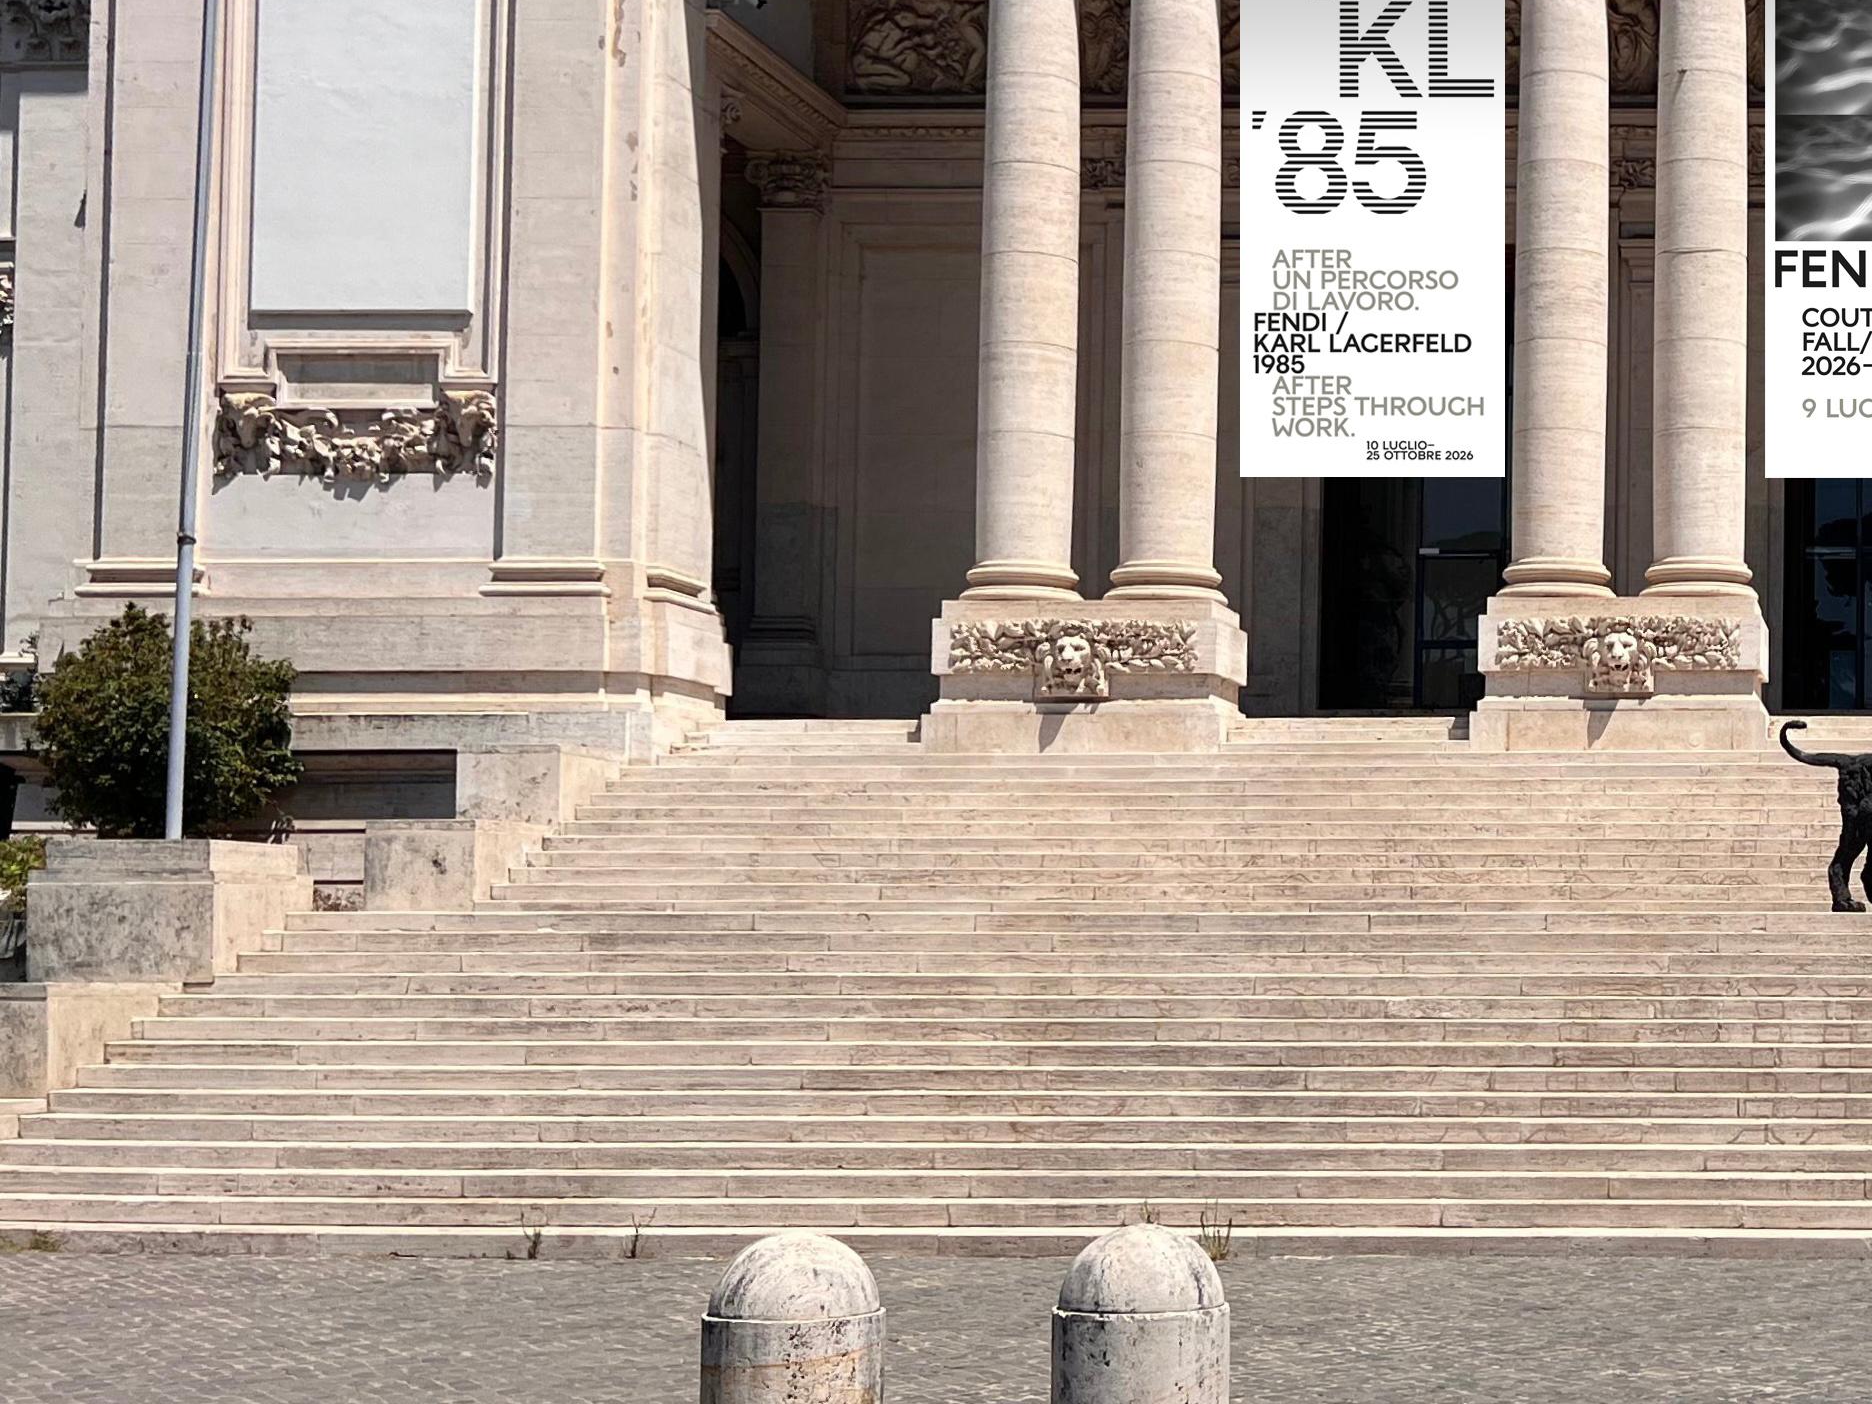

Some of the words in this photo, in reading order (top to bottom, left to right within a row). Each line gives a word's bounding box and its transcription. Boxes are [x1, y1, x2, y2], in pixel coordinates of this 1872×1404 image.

[1252, 110, 1427, 215] '85
[1272, 249, 1351, 268] AFTER
[1273, 270, 1310, 290] UN
[1321, 270, 1458, 290] PERCORSO
[1273, 292, 1297, 310] DI
[1308, 291, 1419, 311] LAVORO.
[1254, 312, 1326, 332] FENDI
[1336, 312, 1349, 334] /
[1254, 334, 1321, 353] KARL
[1330, 334, 1472, 353] LAGERFELD
[1253, 354, 1305, 374] 1985
[1272, 375, 1351, 395] AFTER
[1272, 397, 1346, 416] STEPS
[1354, 397, 1484, 416] THROUGH
[1802, 399, 1816, 418] 9
[1272, 418, 1355, 437] WORK.
[1366, 441, 1379, 450] 10
[1366, 451, 1380, 460] 25
[1384, 451, 1441, 460] OTTOBRE
[1445, 451, 1473, 460] 2026
